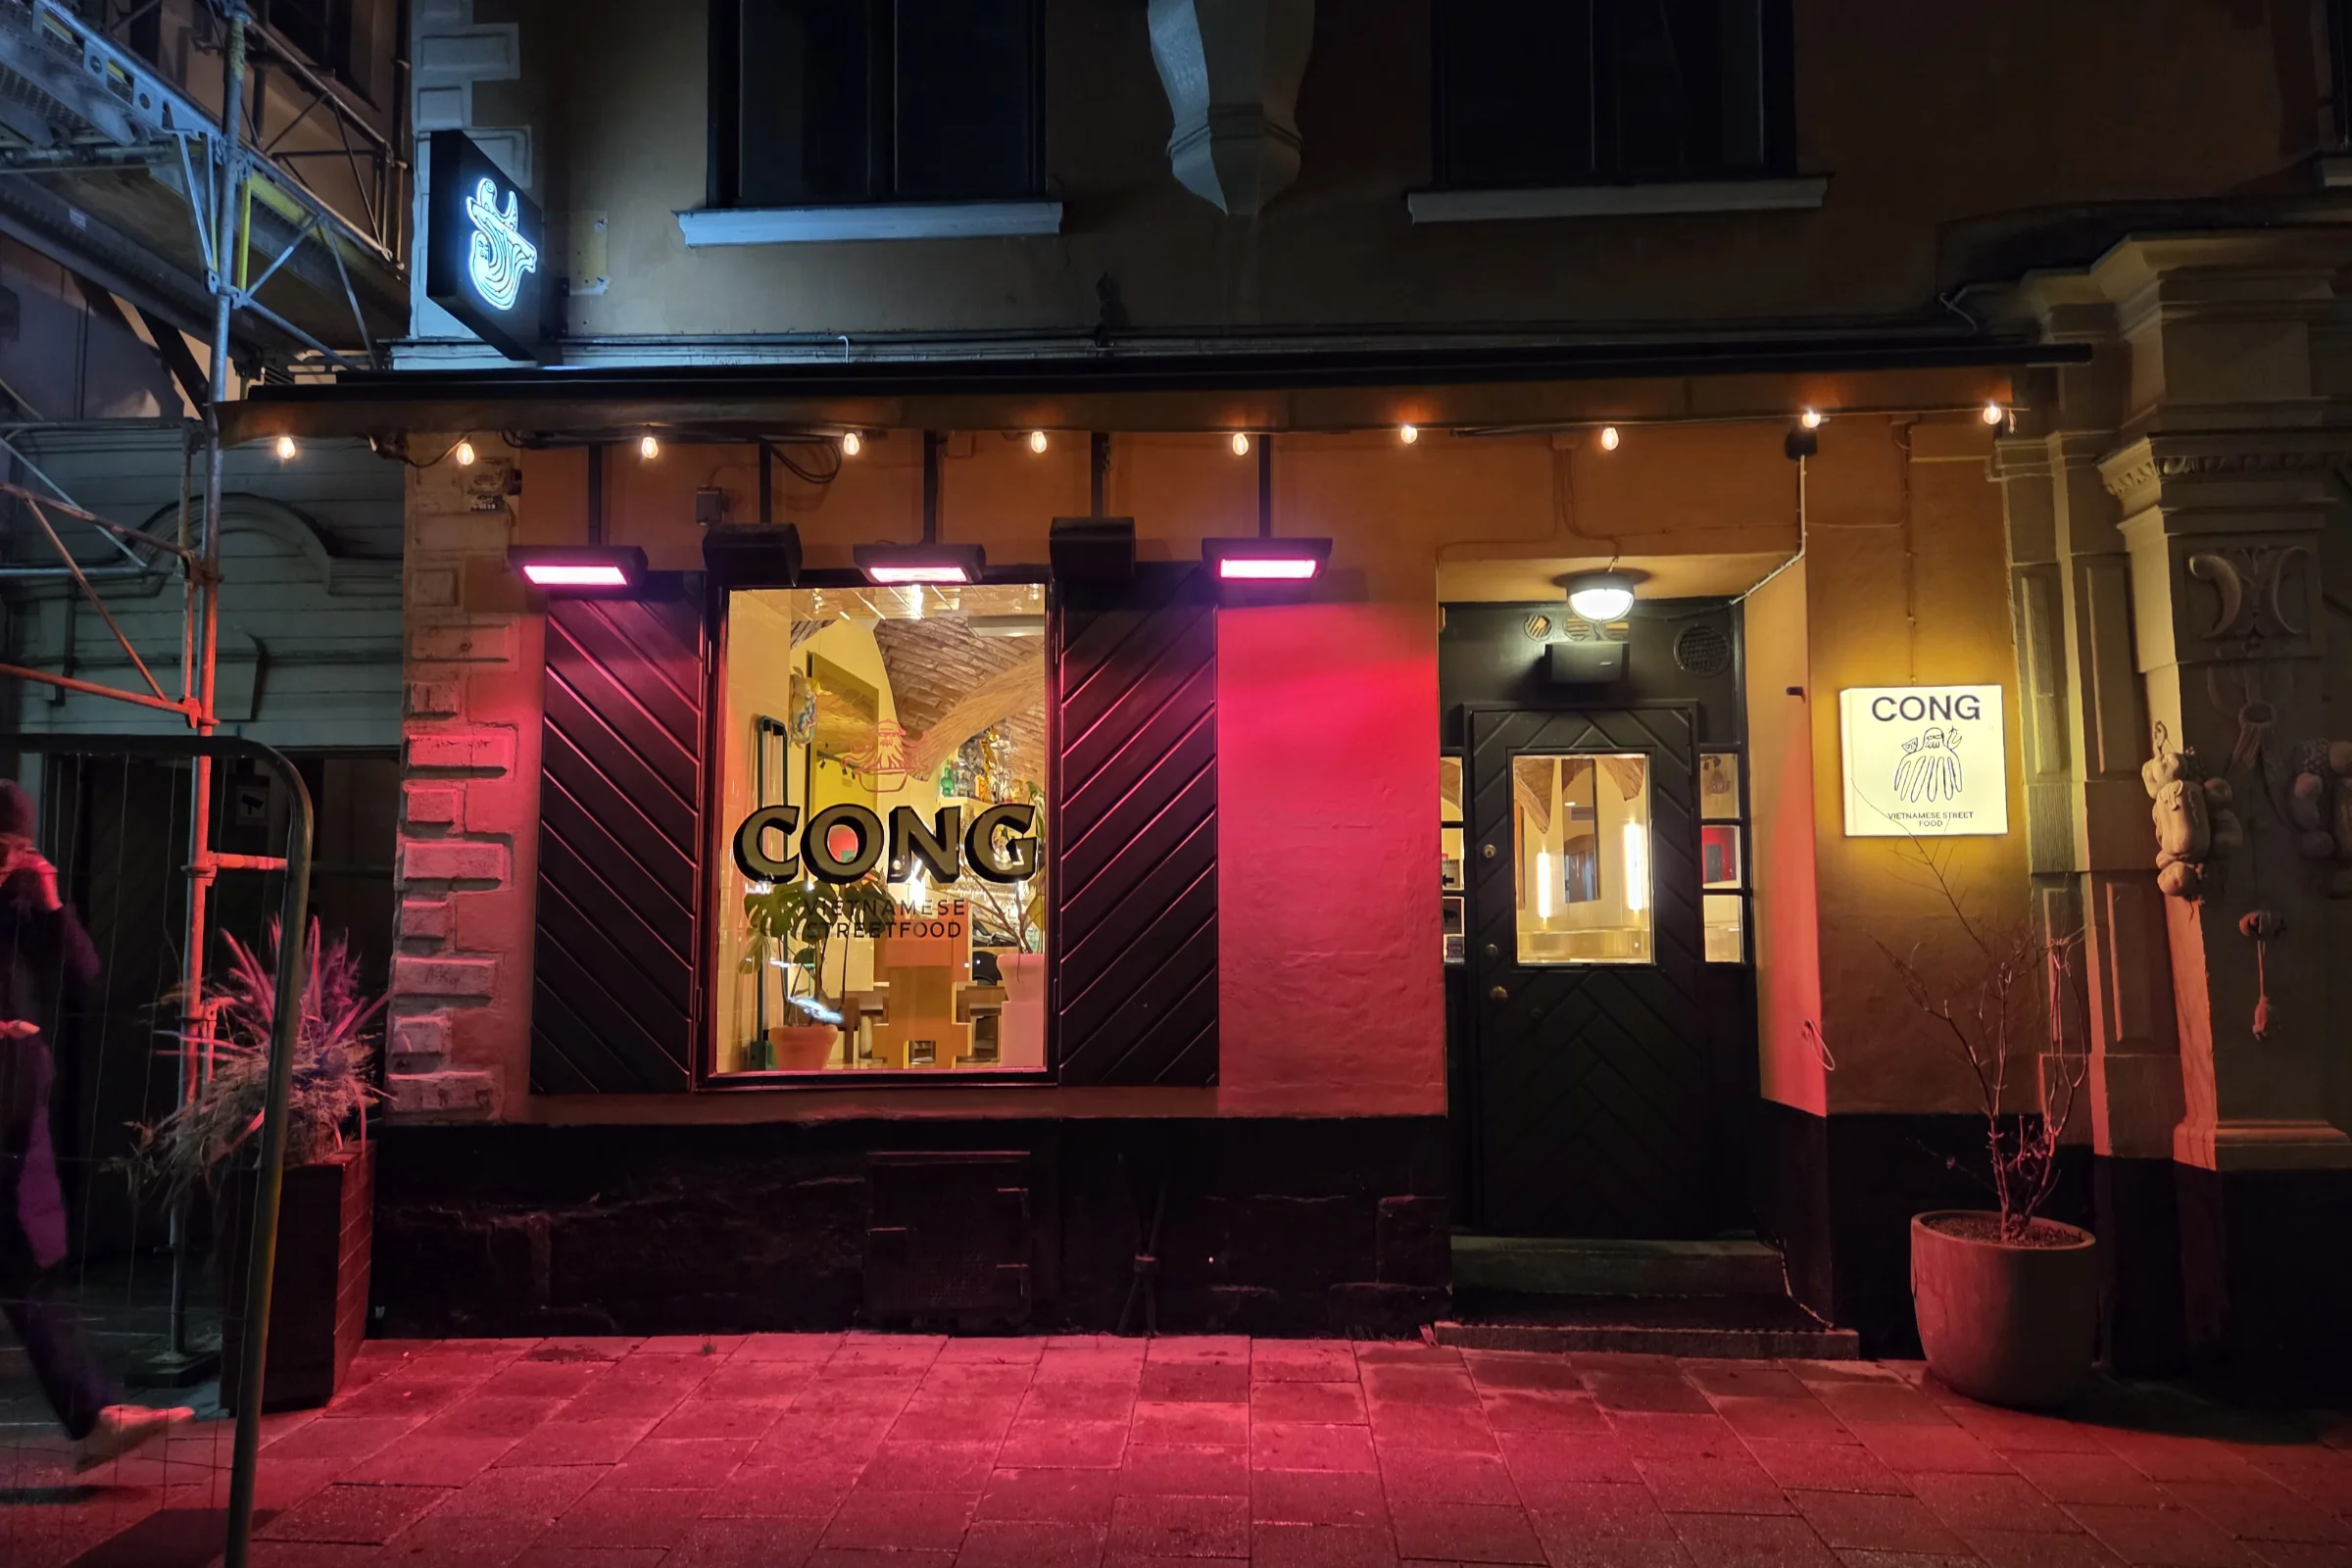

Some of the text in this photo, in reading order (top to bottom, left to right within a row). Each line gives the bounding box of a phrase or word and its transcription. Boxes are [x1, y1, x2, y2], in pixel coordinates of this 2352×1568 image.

[1872, 694, 1981, 722] CONG
[1887, 810, 1974, 820] VIETNAMESE STREET
[733, 803, 1038, 883] CONG
[803, 899, 965, 916] VIETNAMESE
[806, 920, 962, 939] STREETFOOD
